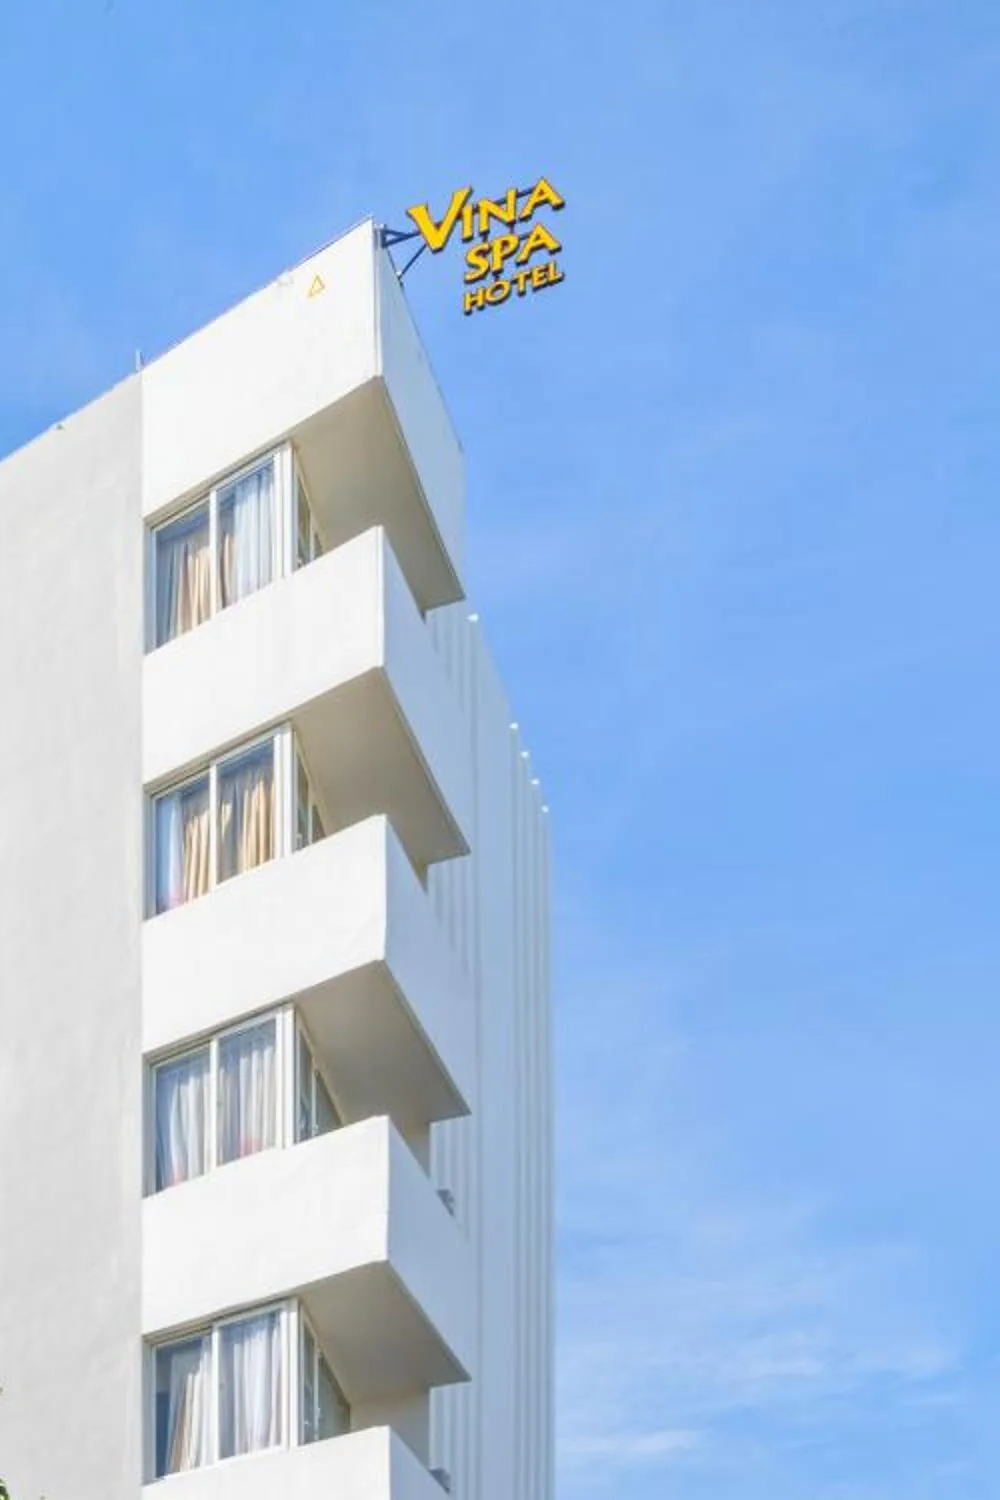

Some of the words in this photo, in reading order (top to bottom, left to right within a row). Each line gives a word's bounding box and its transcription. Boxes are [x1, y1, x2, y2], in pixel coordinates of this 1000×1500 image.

[406, 176, 565, 253] VINA
[464, 222, 562, 284] SPA
[463, 260, 565, 315] HOTEL
